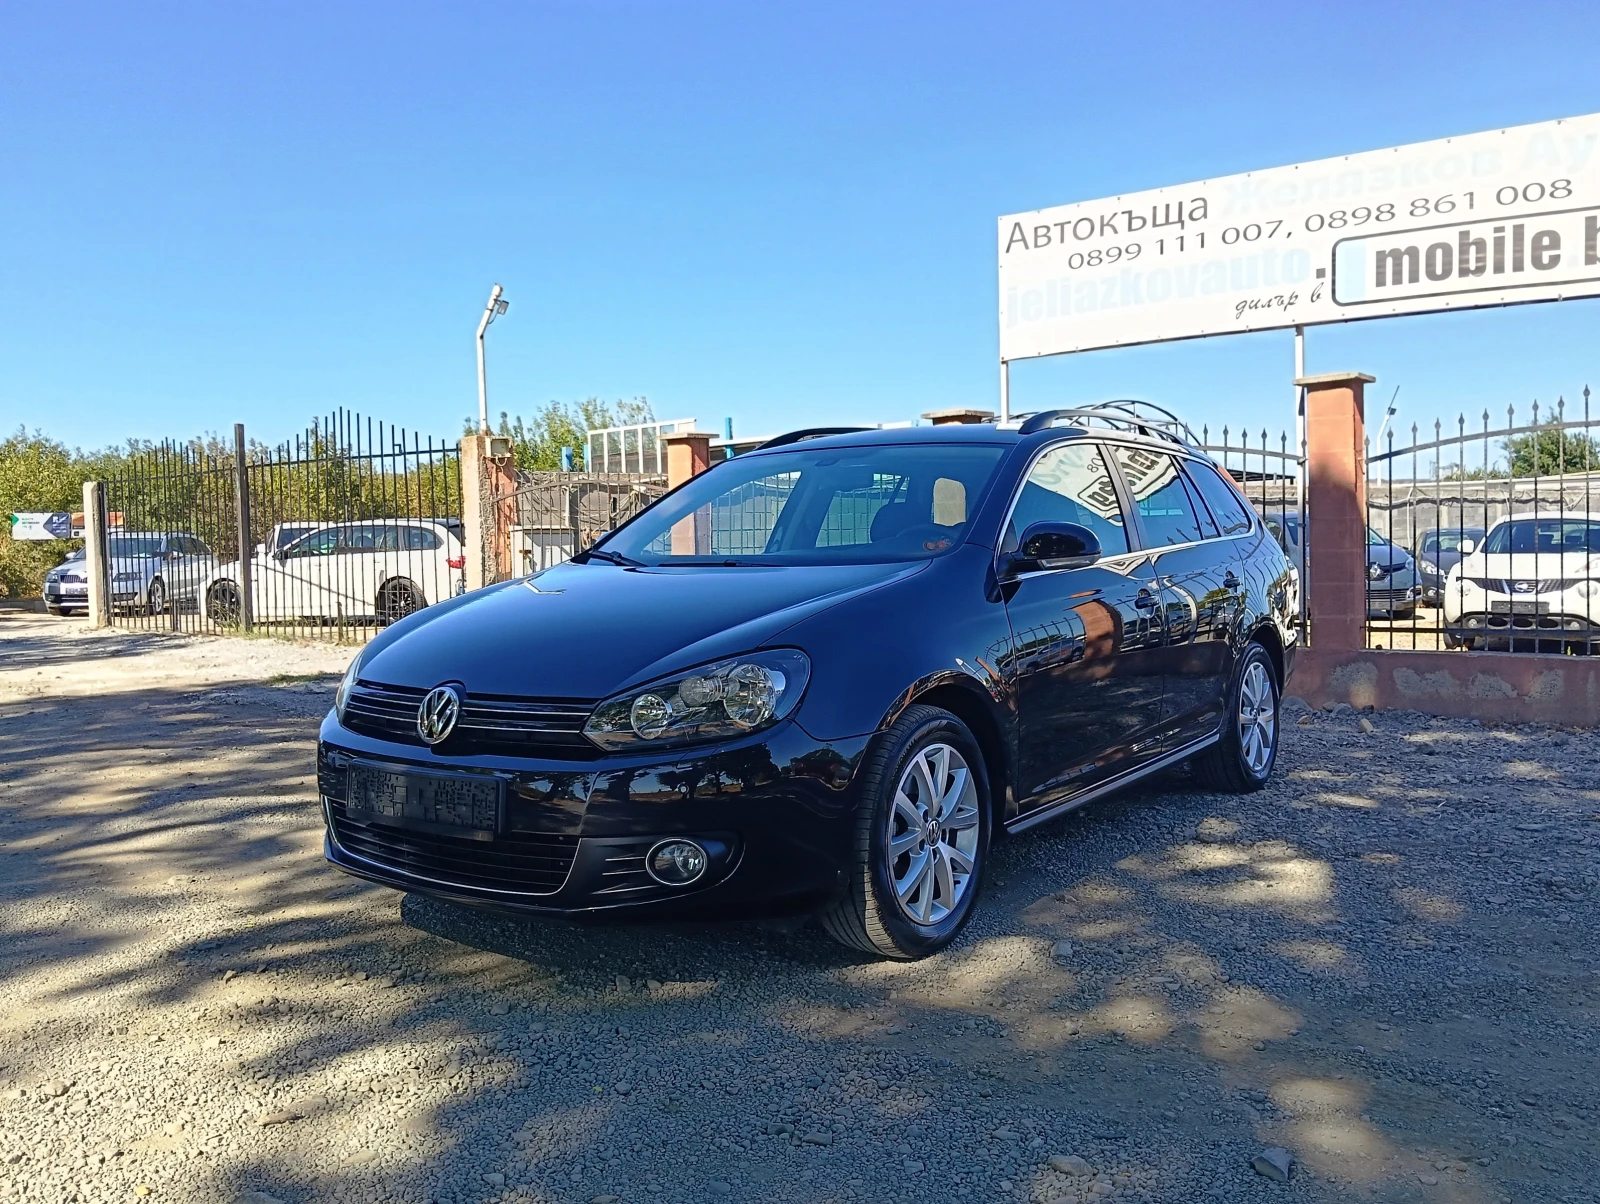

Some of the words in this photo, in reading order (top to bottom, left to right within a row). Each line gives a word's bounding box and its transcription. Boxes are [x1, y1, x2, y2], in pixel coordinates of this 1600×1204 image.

[1005, 197, 1208, 253] Автокъща
[1068, 243, 1142, 270] 0899
[1155, 232, 1205, 255] 111
[1221, 219, 1292, 245] 007,
[1304, 203, 1396, 232] 0898
[1409, 191, 1474, 217] 861
[1495, 179, 1573, 206] 008
